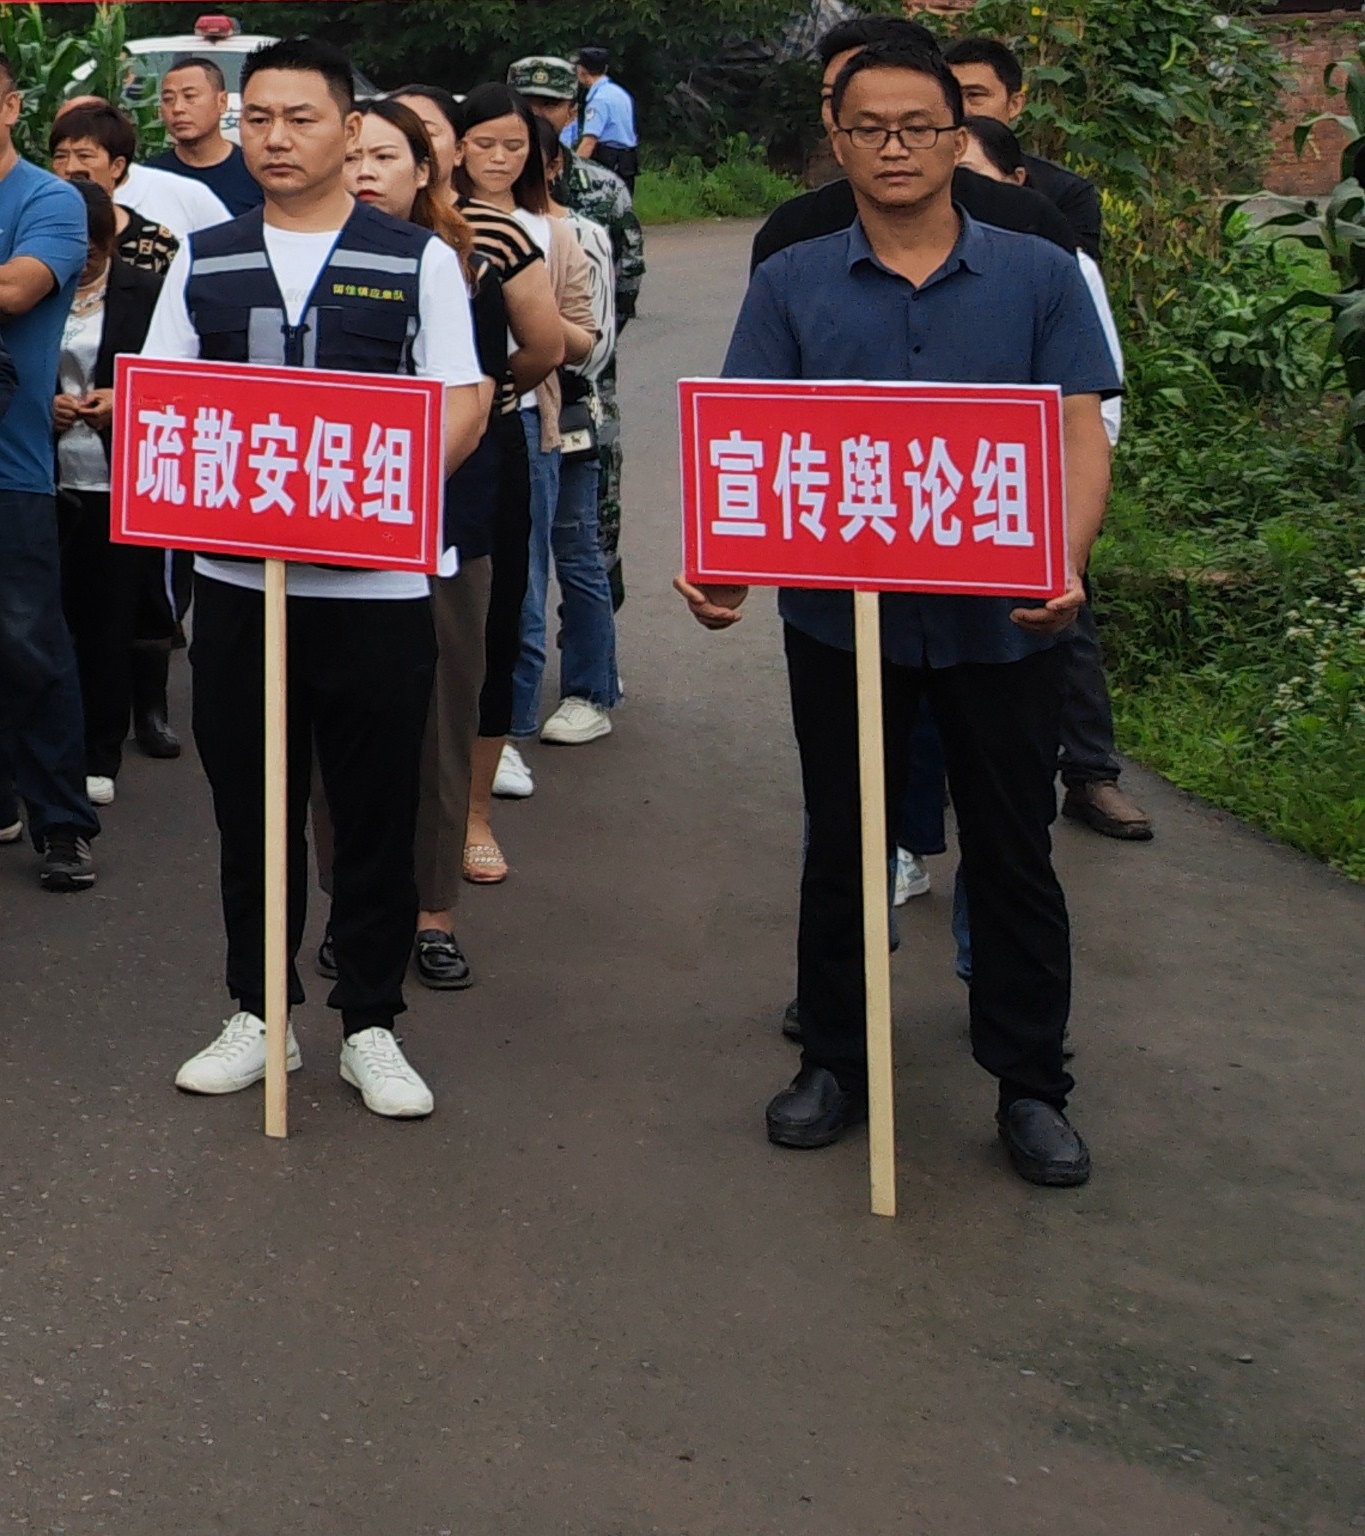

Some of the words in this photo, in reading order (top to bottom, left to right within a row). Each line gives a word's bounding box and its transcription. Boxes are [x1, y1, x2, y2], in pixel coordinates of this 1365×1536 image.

[135, 404, 415, 525] 疏散安保组
[709, 429, 1035, 547] 宣传舆论组
